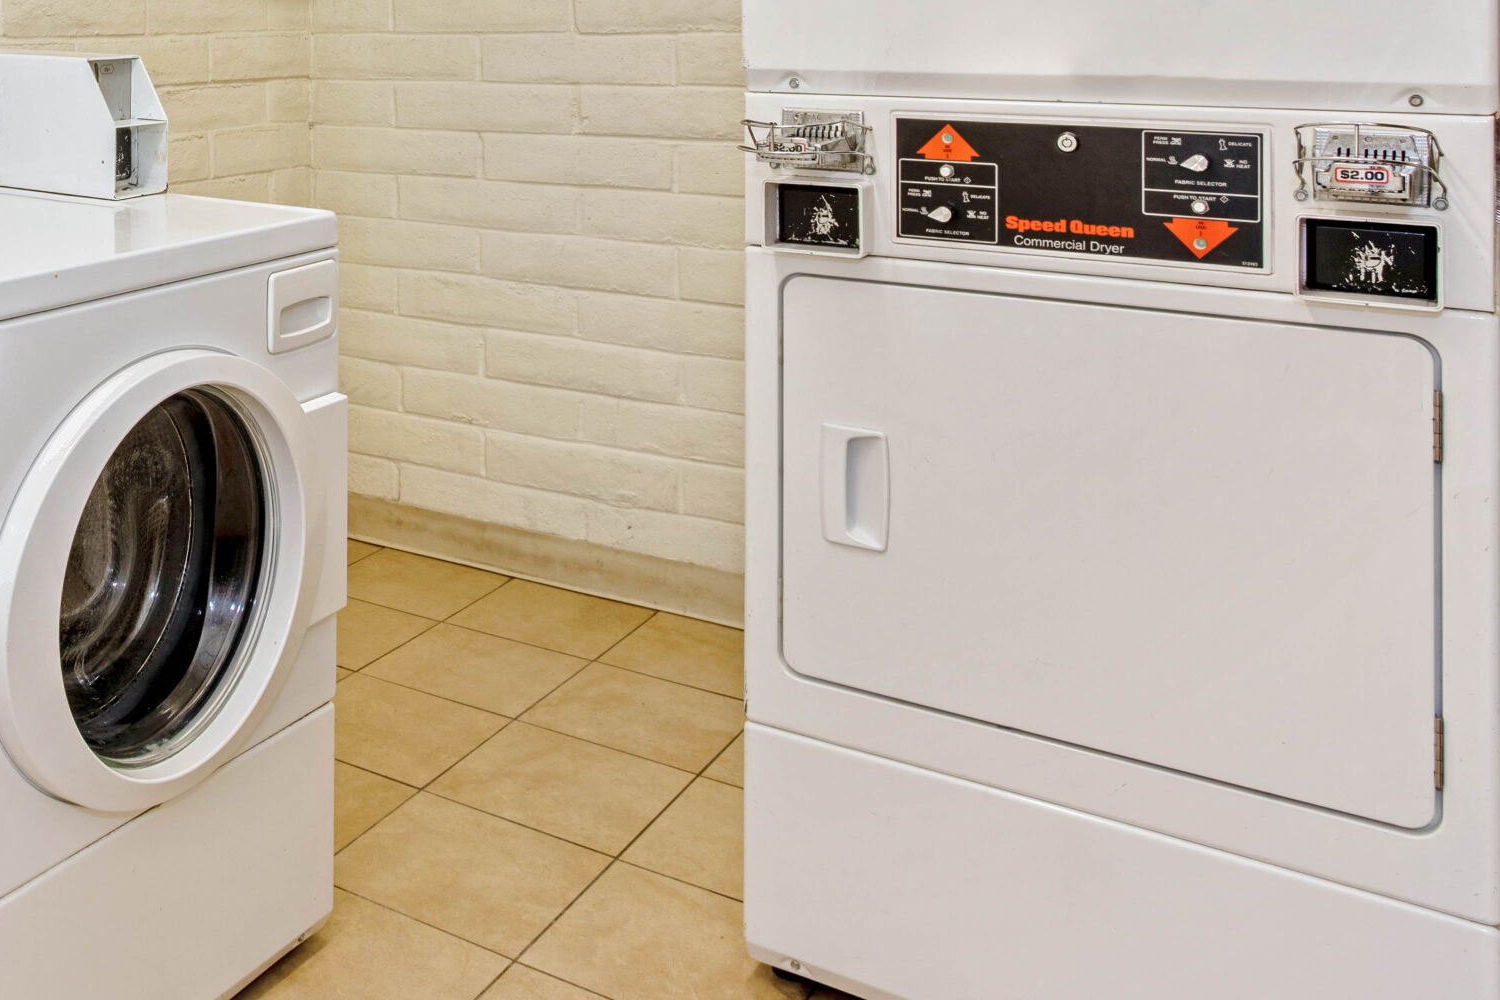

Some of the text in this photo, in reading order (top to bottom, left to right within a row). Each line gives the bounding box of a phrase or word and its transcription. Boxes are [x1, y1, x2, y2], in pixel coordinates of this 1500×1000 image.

[1340, 169, 1385, 181] $2.00
[1005, 215, 1135, 238] Speed Queen
[1013, 235, 1125, 255] Commercial Dryer
